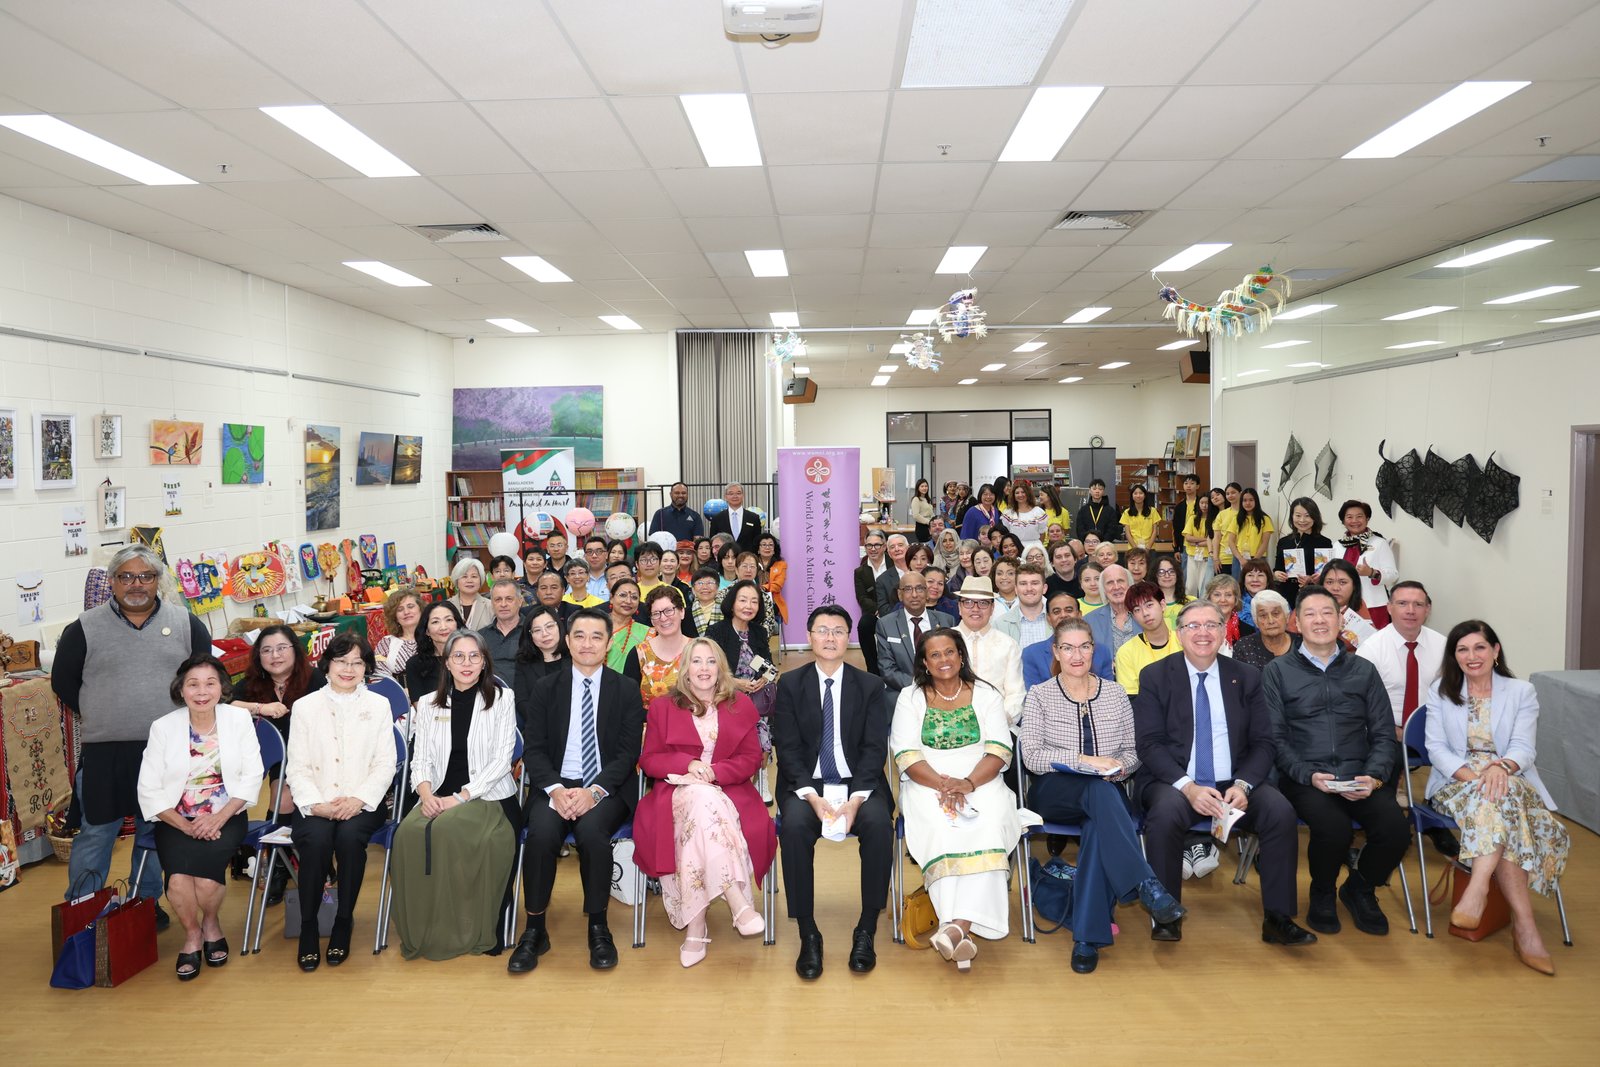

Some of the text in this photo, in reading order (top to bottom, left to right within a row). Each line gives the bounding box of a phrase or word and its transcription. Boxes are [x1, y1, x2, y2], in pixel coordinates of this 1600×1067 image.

[805, 490, 814, 519] World
[805, 522, 814, 542] Arts
[806, 545, 815, 554] &
